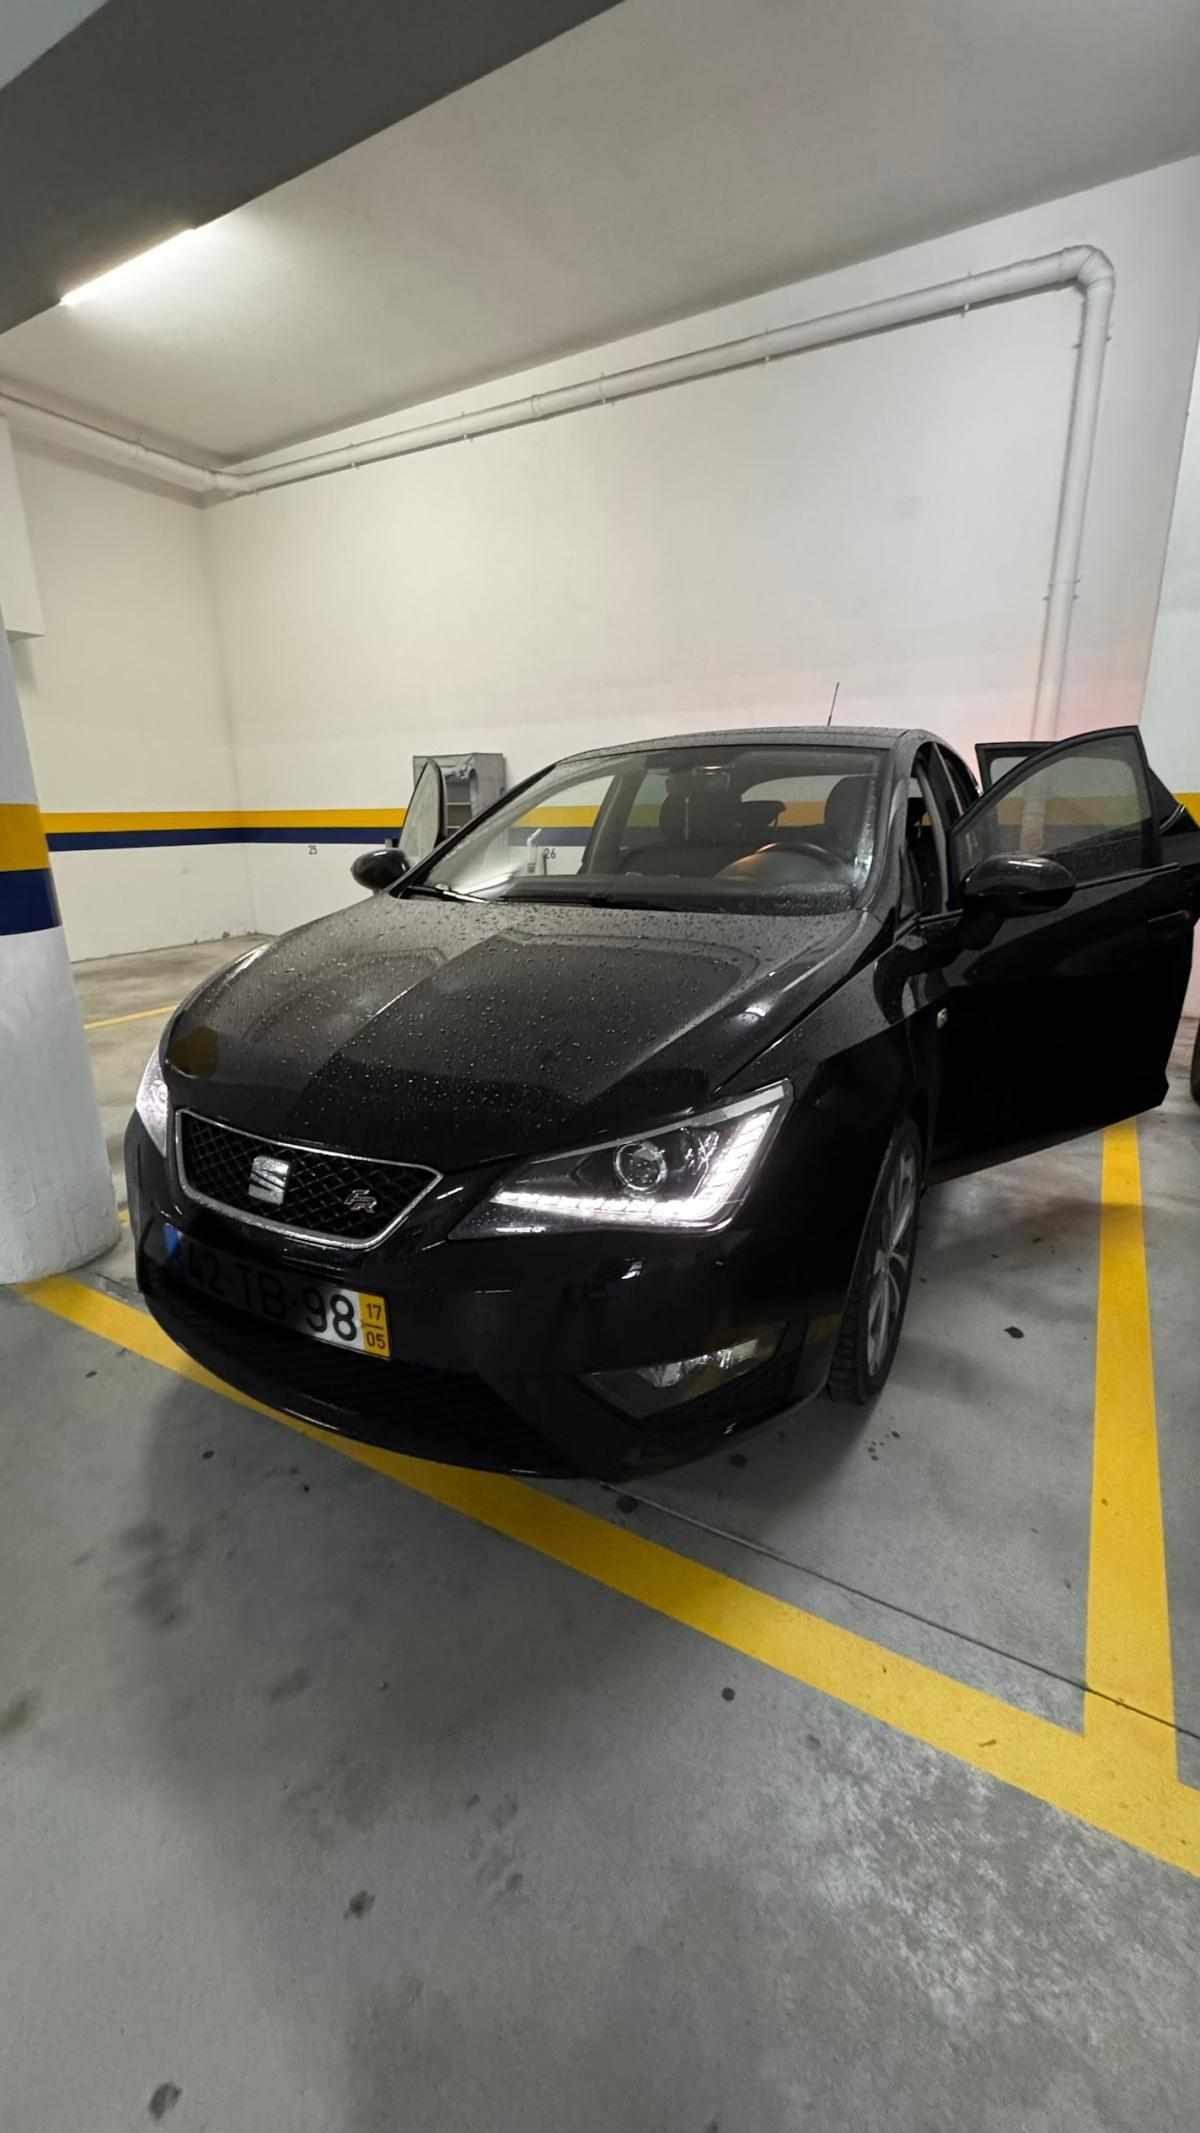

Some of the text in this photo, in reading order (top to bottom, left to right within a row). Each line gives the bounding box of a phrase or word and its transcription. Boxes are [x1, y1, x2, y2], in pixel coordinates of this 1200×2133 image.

[543, 847, 557, 860] 26
[366, 1303, 382, 1321] 17
[366, 1331, 385, 1350] 05
